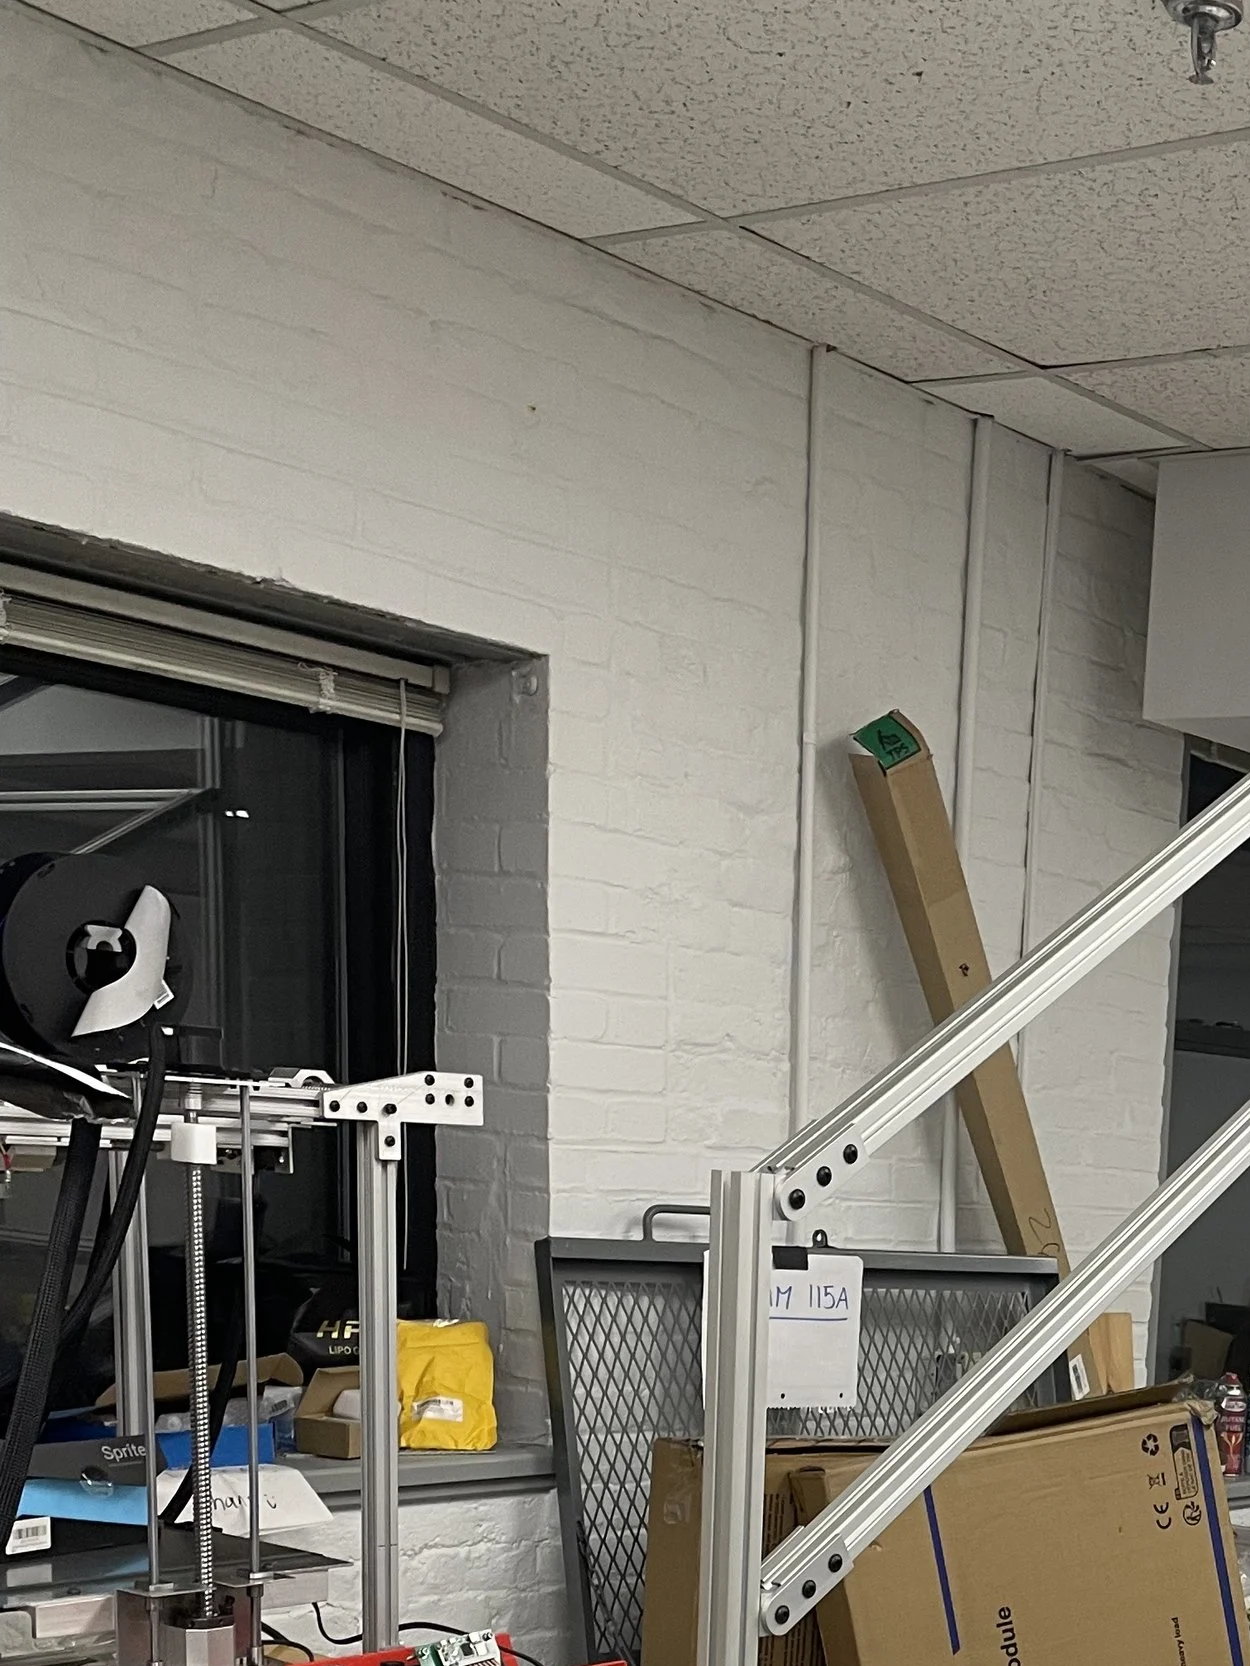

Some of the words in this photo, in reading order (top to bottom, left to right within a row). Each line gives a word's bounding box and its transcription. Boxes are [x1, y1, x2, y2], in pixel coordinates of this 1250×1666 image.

[809, 1284, 849, 1310] 115A
[328, 1345, 352, 1355] LIPO
[101, 1443, 147, 1462] Sprite
